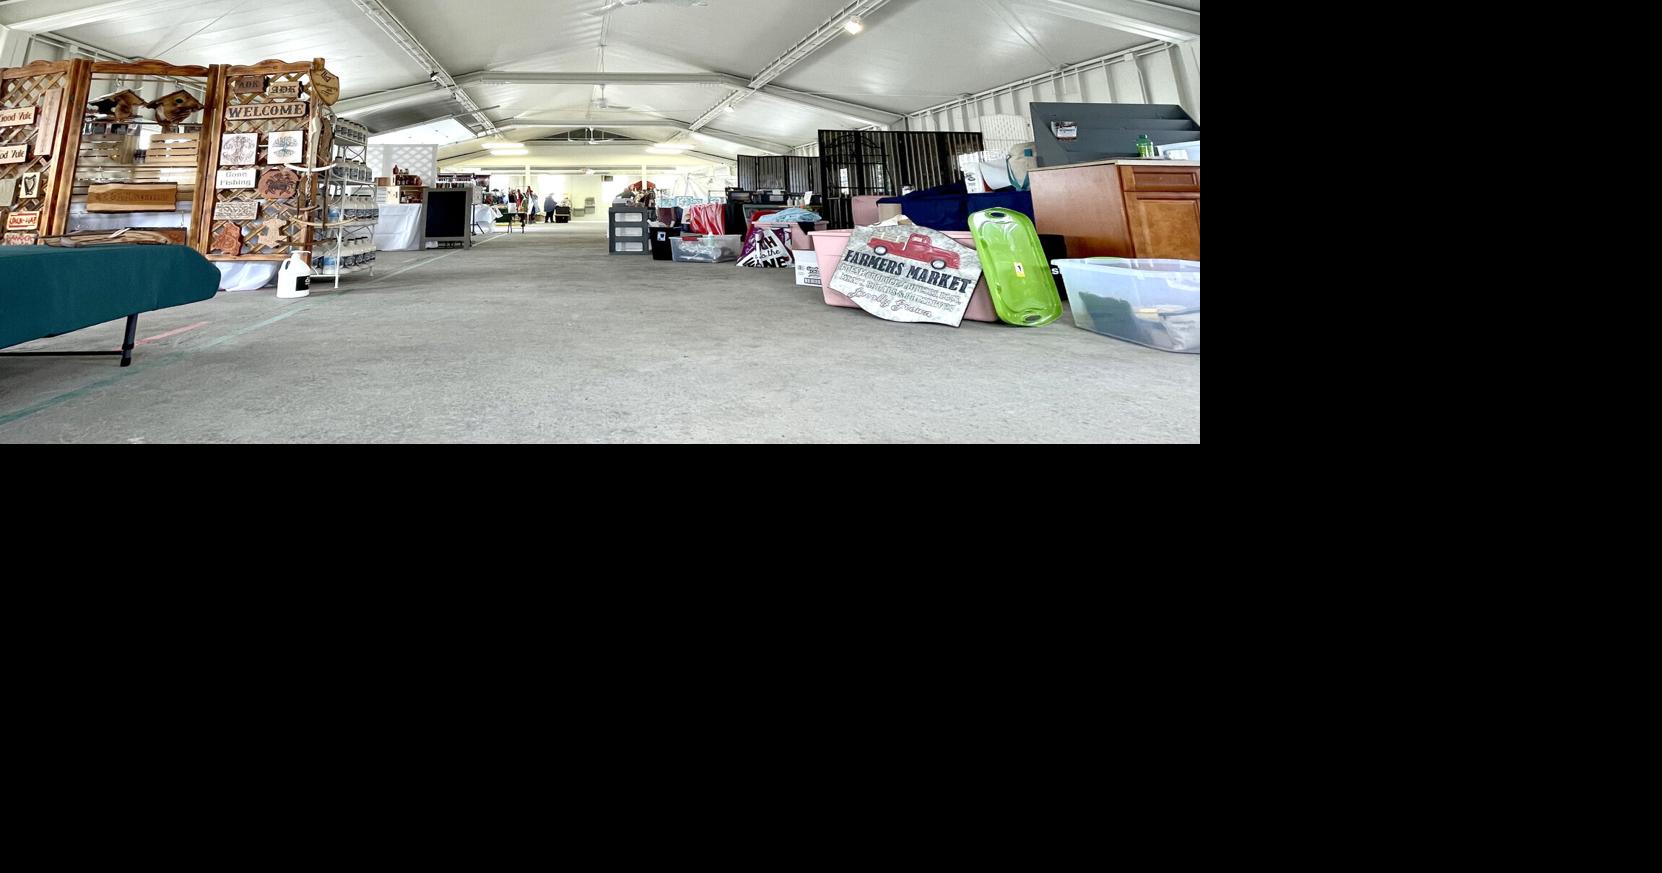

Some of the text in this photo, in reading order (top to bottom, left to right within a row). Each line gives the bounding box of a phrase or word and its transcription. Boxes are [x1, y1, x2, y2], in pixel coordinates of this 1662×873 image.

[229, 104, 304, 118] WELCOME
[843, 250, 905, 276] FARMERS
[906, 265, 972, 293] MARKET
